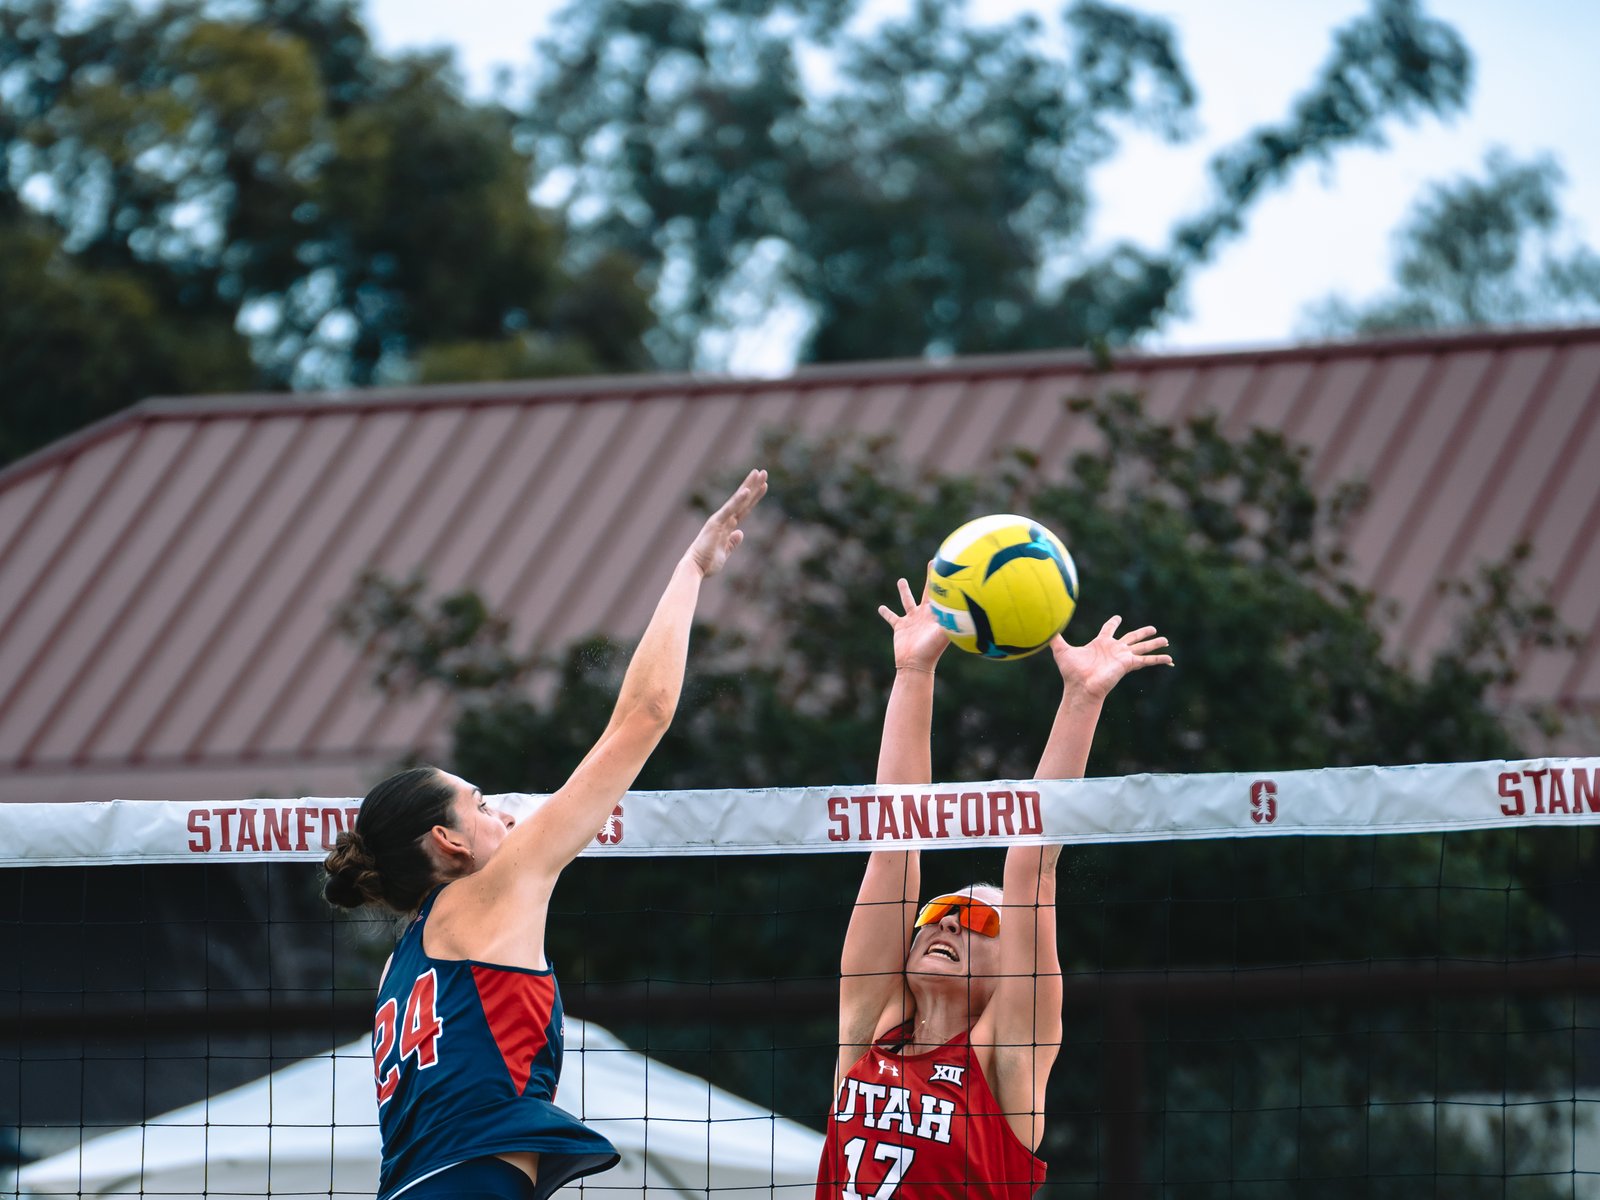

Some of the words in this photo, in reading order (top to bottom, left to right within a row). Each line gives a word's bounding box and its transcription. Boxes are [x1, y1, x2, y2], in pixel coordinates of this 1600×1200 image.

[827, 790, 1043, 842] STANFORD
[1498, 767, 1600, 816] STAN
[374, 967, 443, 1108] 24
[833, 1077, 955, 1143] UTAH
